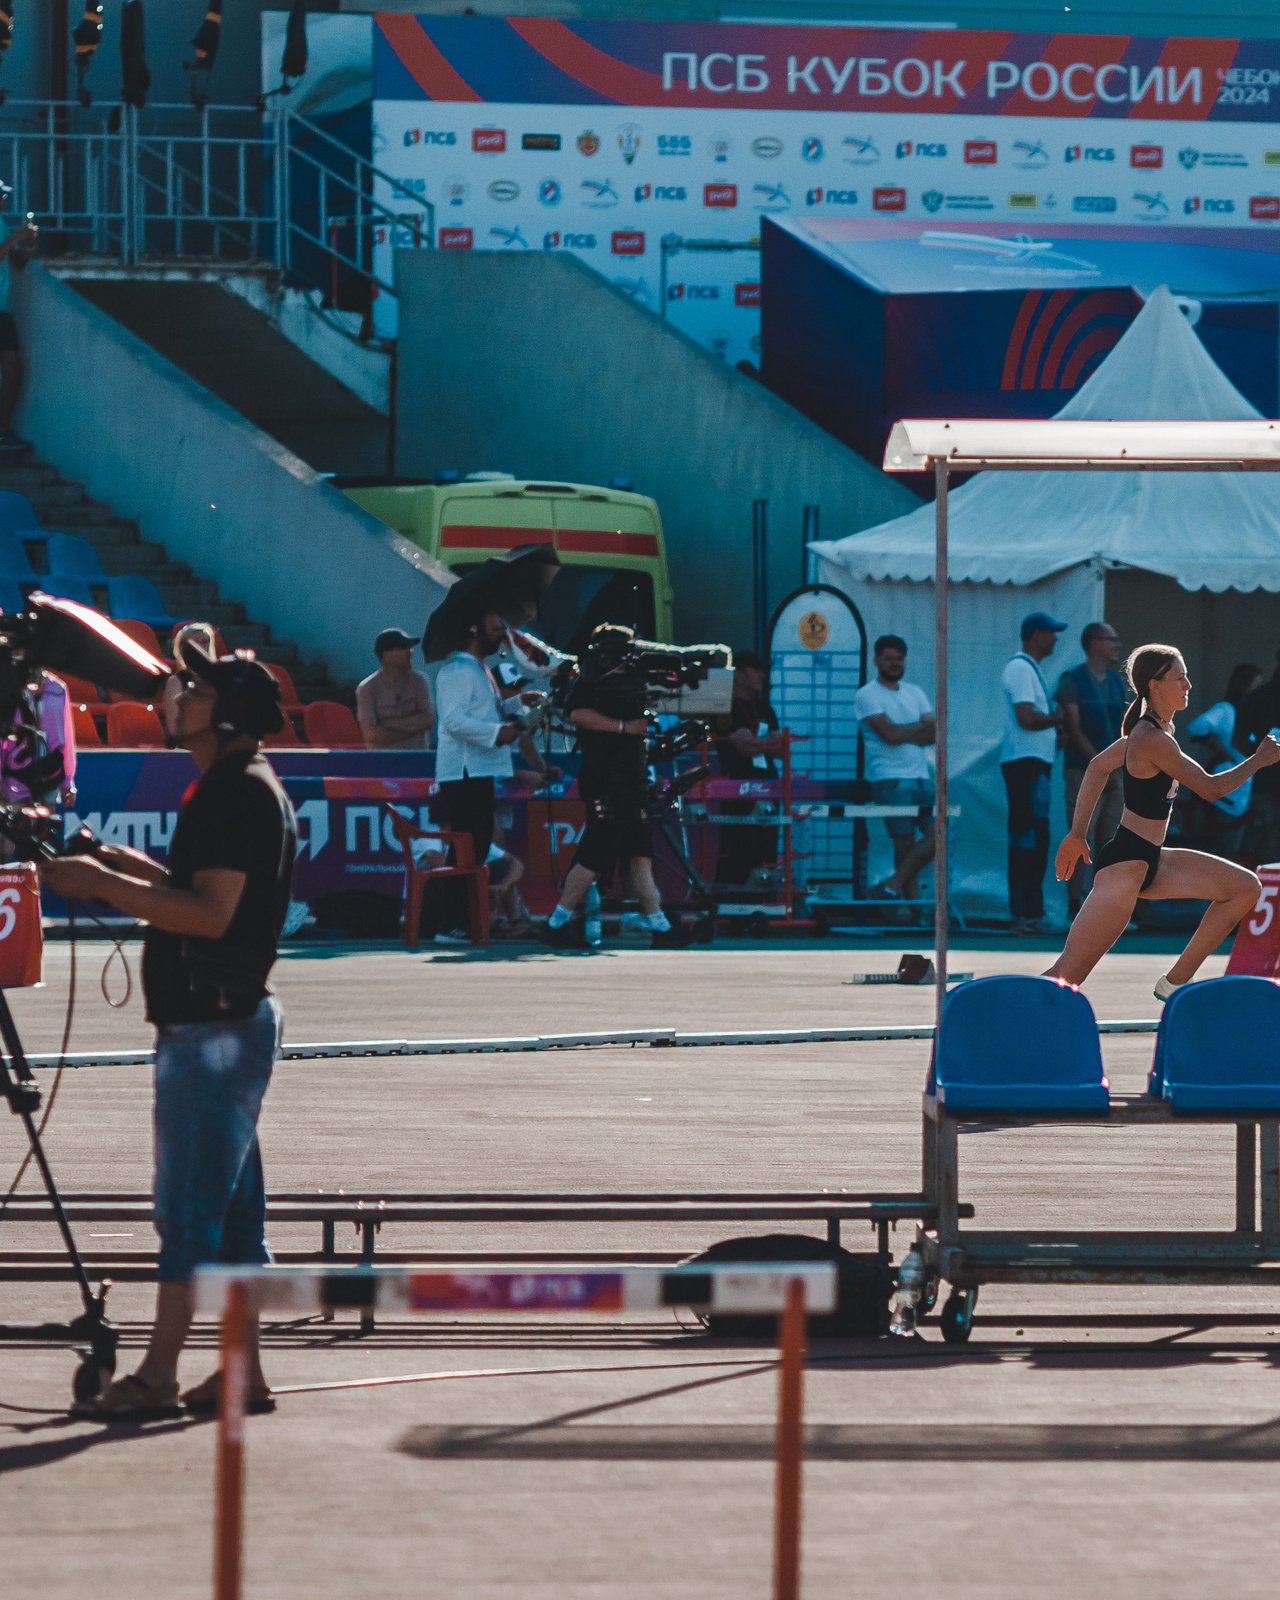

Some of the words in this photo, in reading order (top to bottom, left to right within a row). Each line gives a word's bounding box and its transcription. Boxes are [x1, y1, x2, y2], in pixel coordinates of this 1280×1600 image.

[662, 52, 770, 93] ПСБ
[787, 55, 967, 98] КУБОК
[986, 61, 1202, 104] РОССИИ
[1217, 86, 1270, 104] 2024
[1249, 886, 1279, 936] 5
